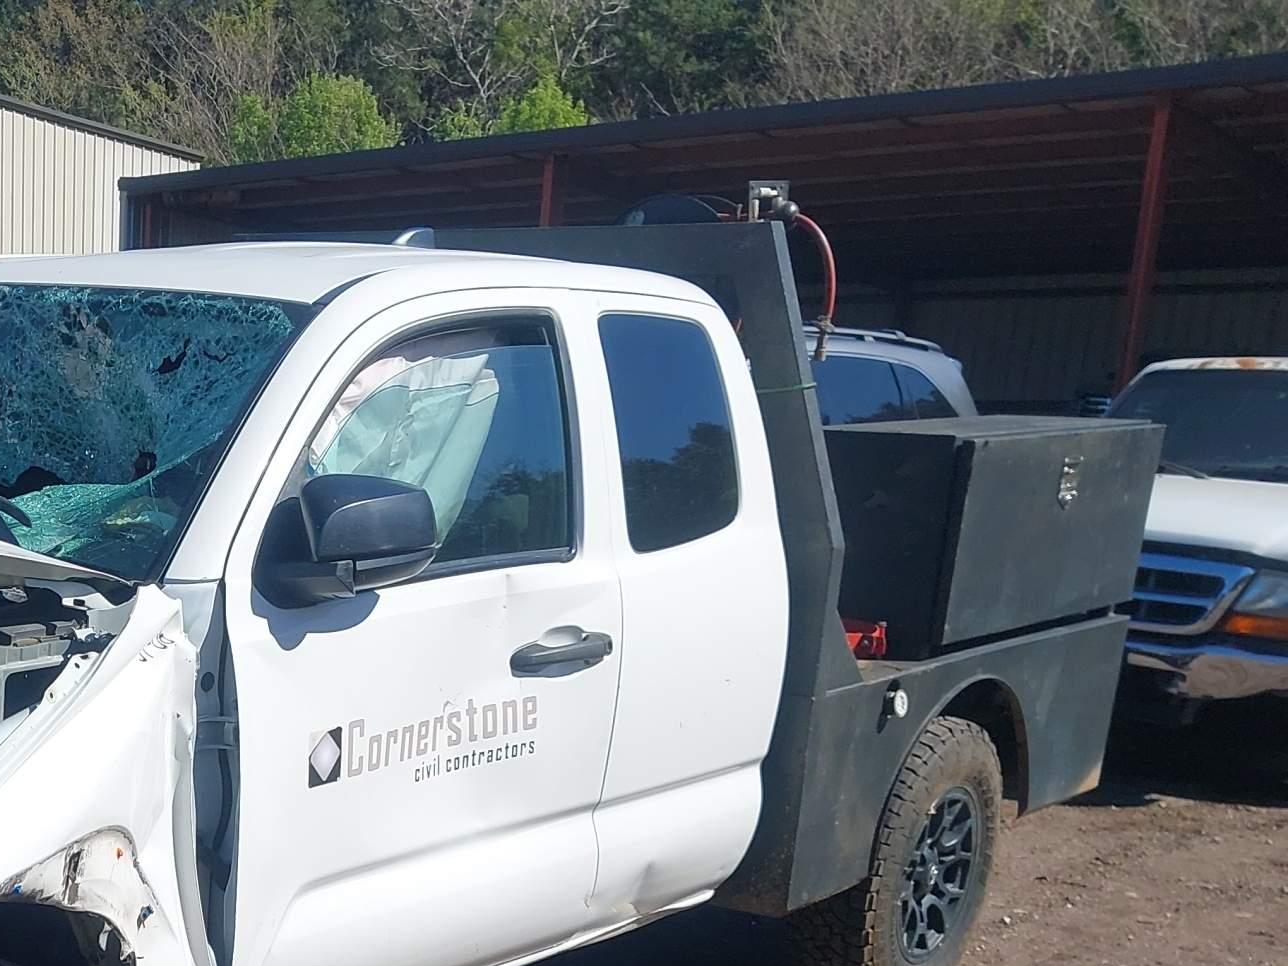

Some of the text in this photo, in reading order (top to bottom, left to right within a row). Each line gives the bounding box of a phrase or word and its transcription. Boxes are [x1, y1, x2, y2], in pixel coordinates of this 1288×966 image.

[347, 695, 537, 777] Cornerstone
[414, 740, 535, 782] civil contractors
